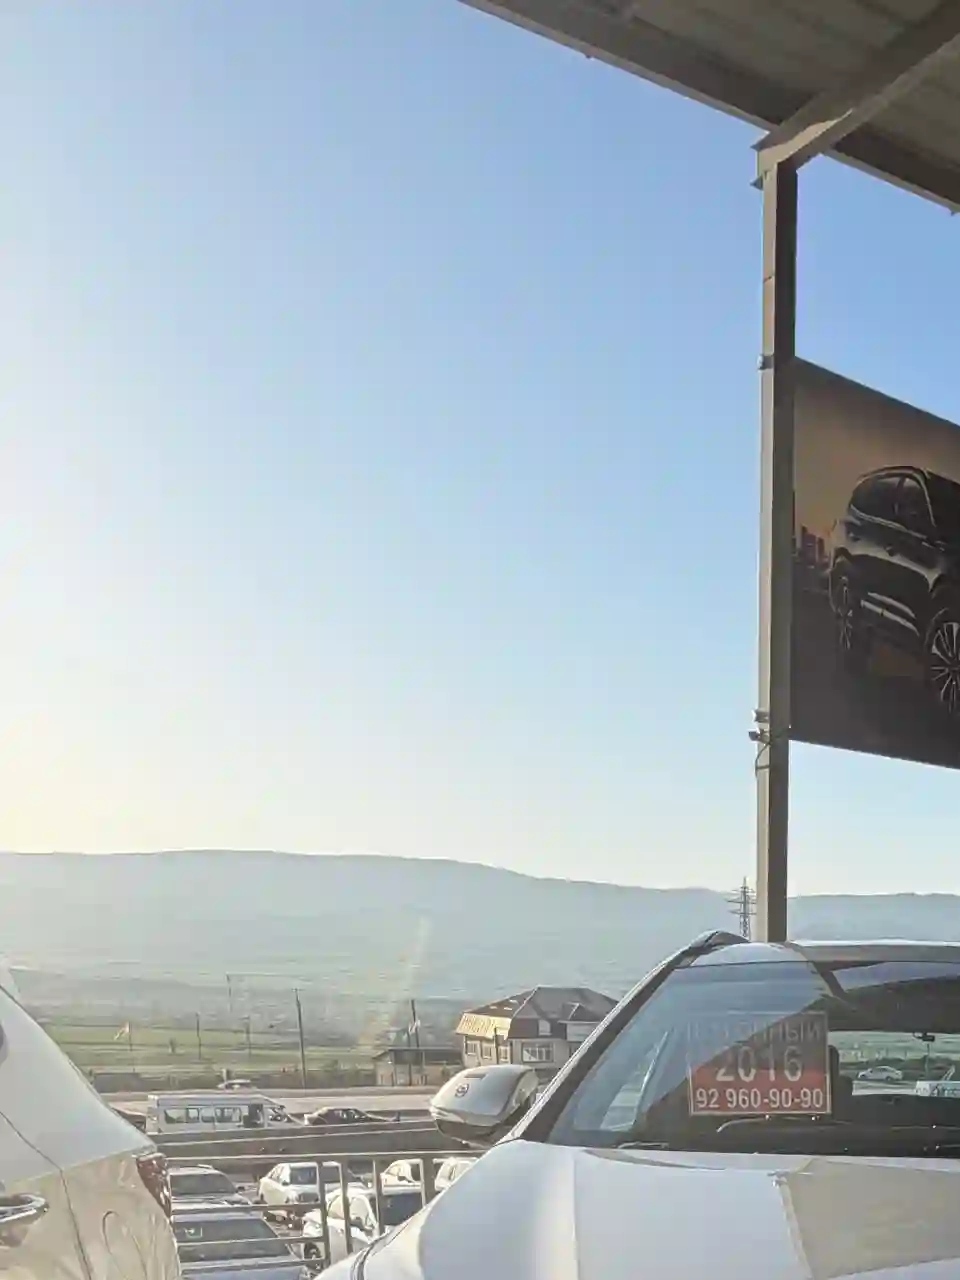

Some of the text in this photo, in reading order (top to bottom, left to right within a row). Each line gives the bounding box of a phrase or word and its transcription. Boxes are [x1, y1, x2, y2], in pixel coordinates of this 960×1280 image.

[715, 1045, 803, 1082] 2016
[695, 1088, 824, 1109] 92 960-90-90
